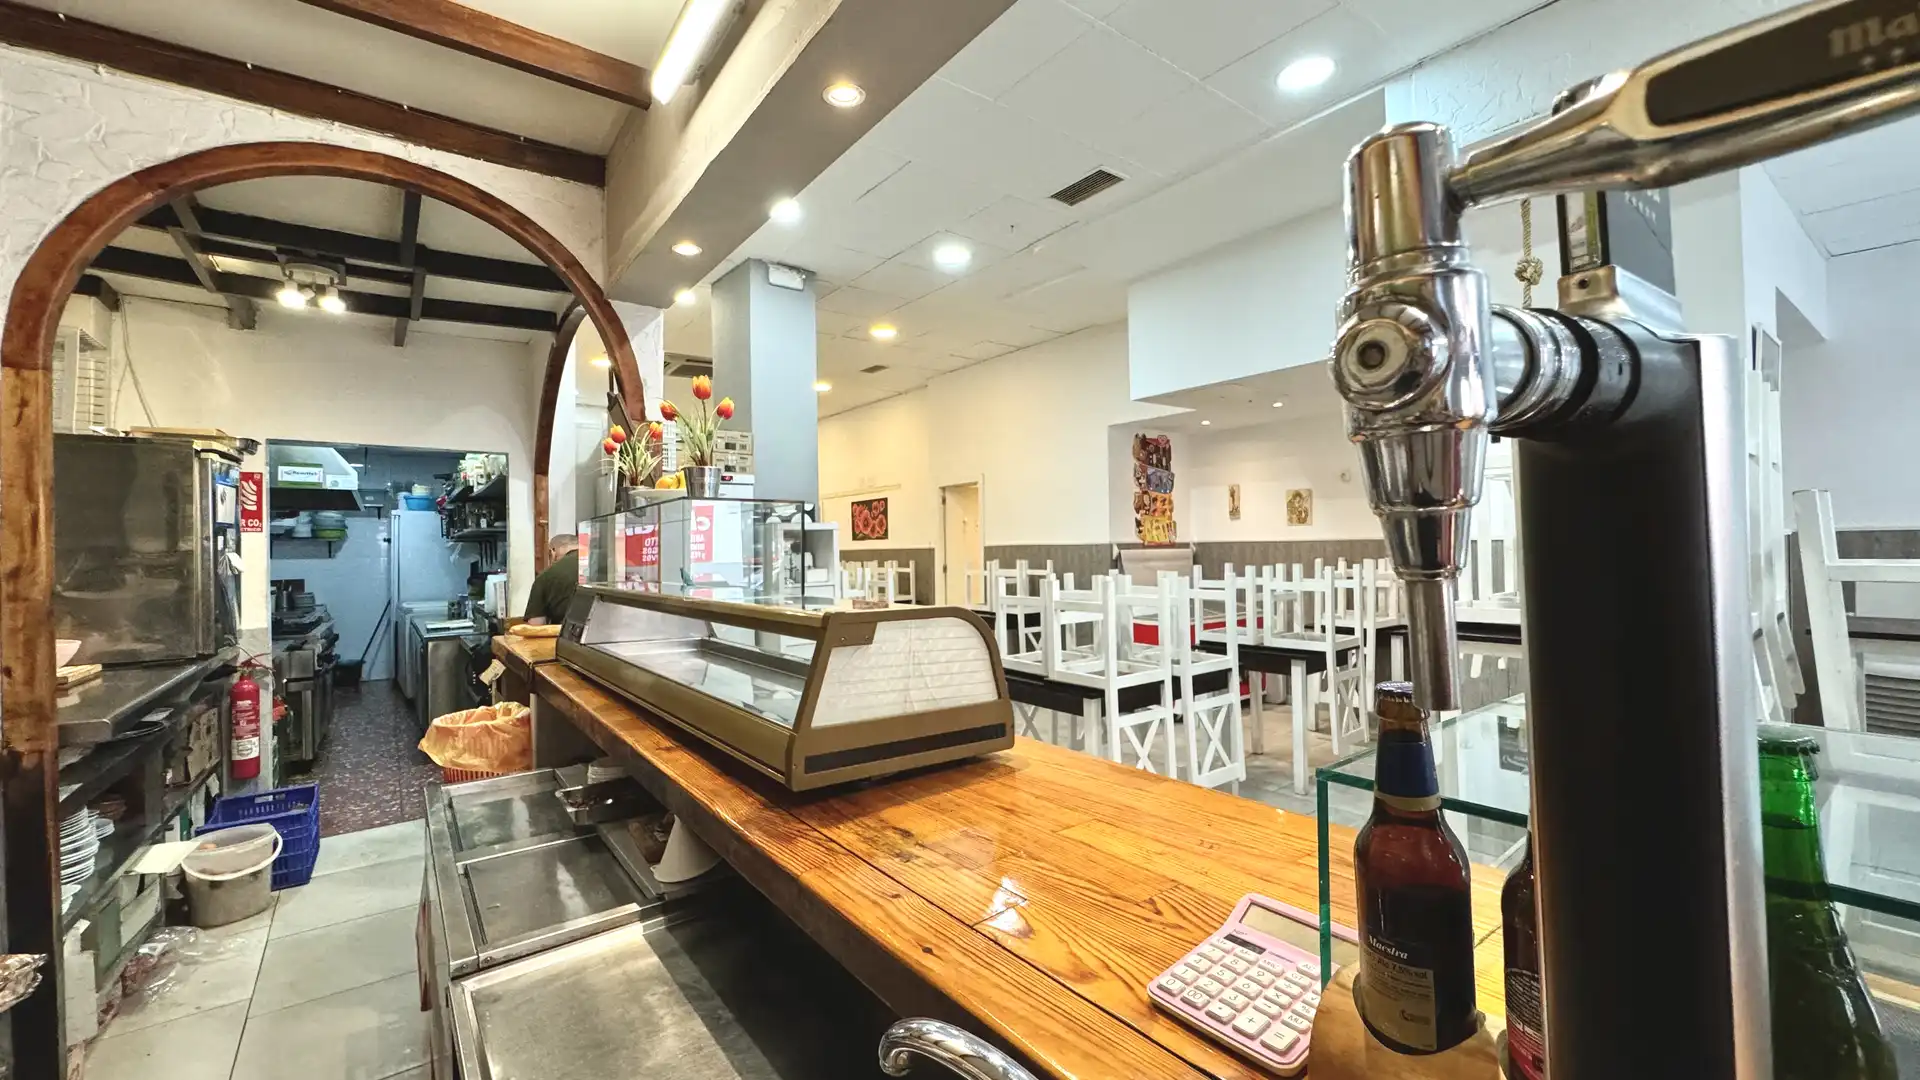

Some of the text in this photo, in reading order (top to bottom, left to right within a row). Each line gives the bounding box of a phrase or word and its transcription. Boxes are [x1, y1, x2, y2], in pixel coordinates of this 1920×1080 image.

[1368, 934, 1408, 960] Maestra
[1204, 980, 1214, 988] 2
[1186, 989, 1203, 1001] 00
